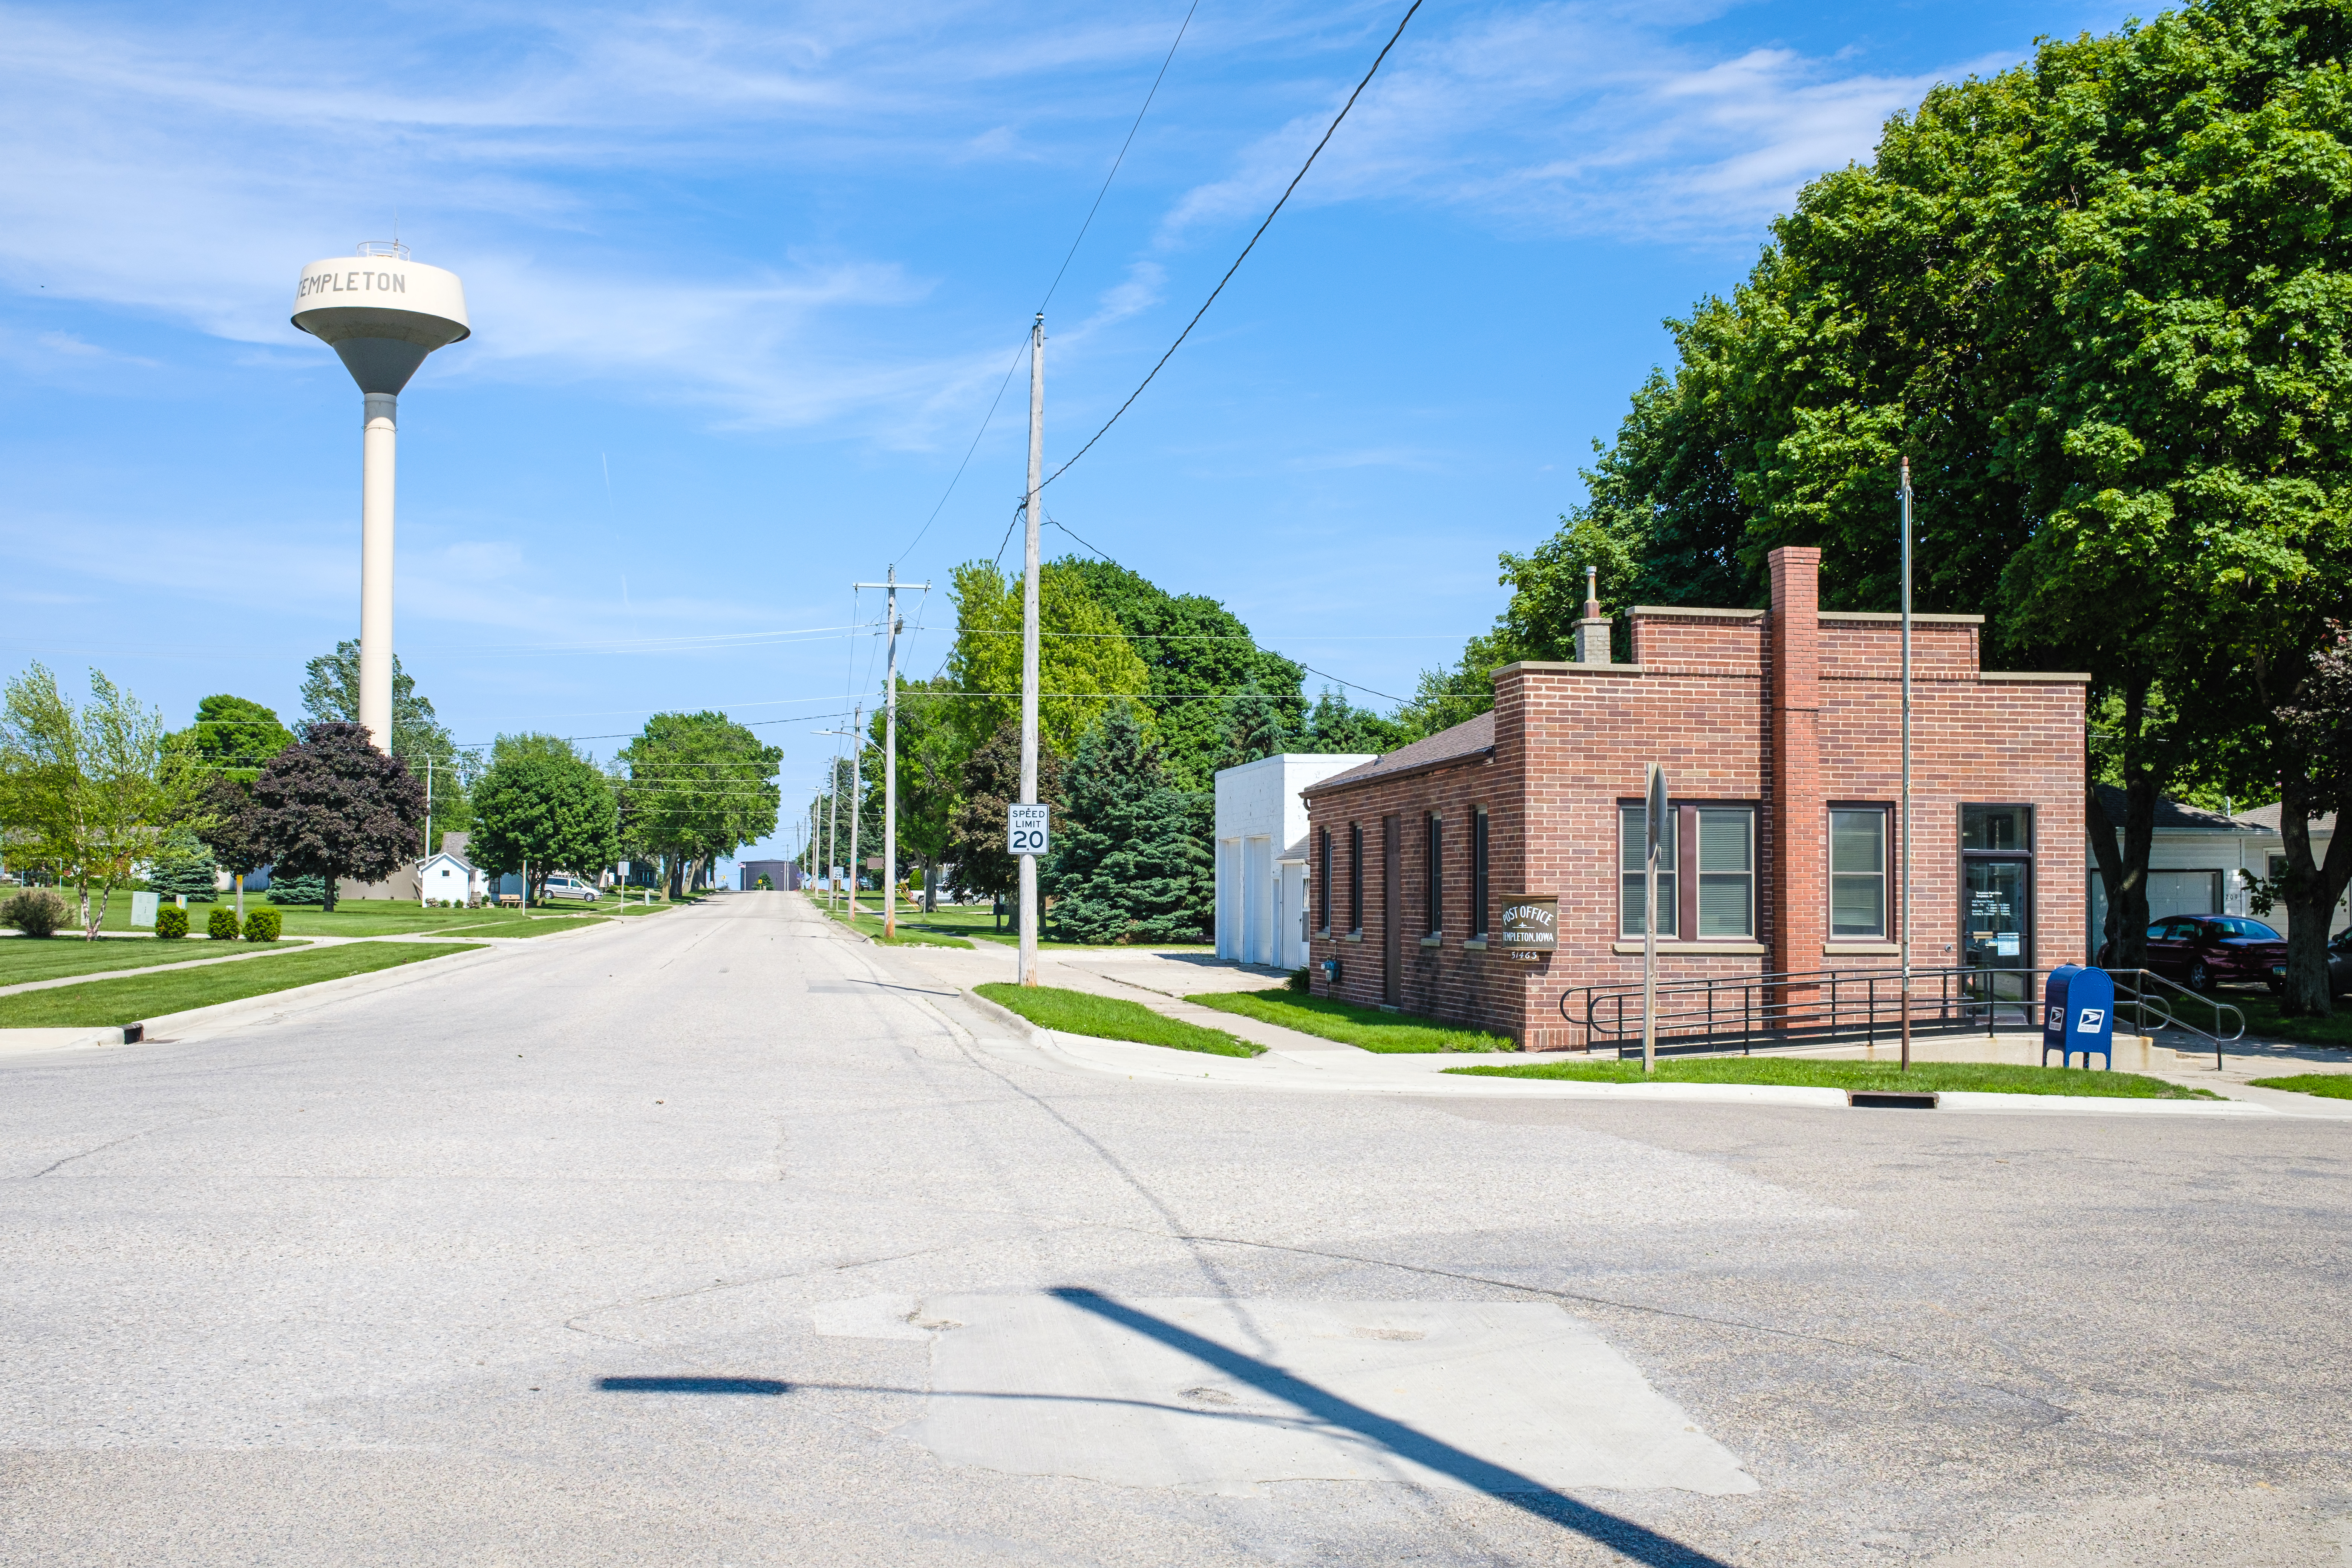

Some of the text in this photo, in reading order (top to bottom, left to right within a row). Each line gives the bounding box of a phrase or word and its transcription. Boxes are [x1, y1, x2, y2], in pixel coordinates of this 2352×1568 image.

[297, 272, 405, 300] TEMPLETON
[1013, 831, 1043, 848] 20
[1503, 906, 1554, 926] POST OFFICE
